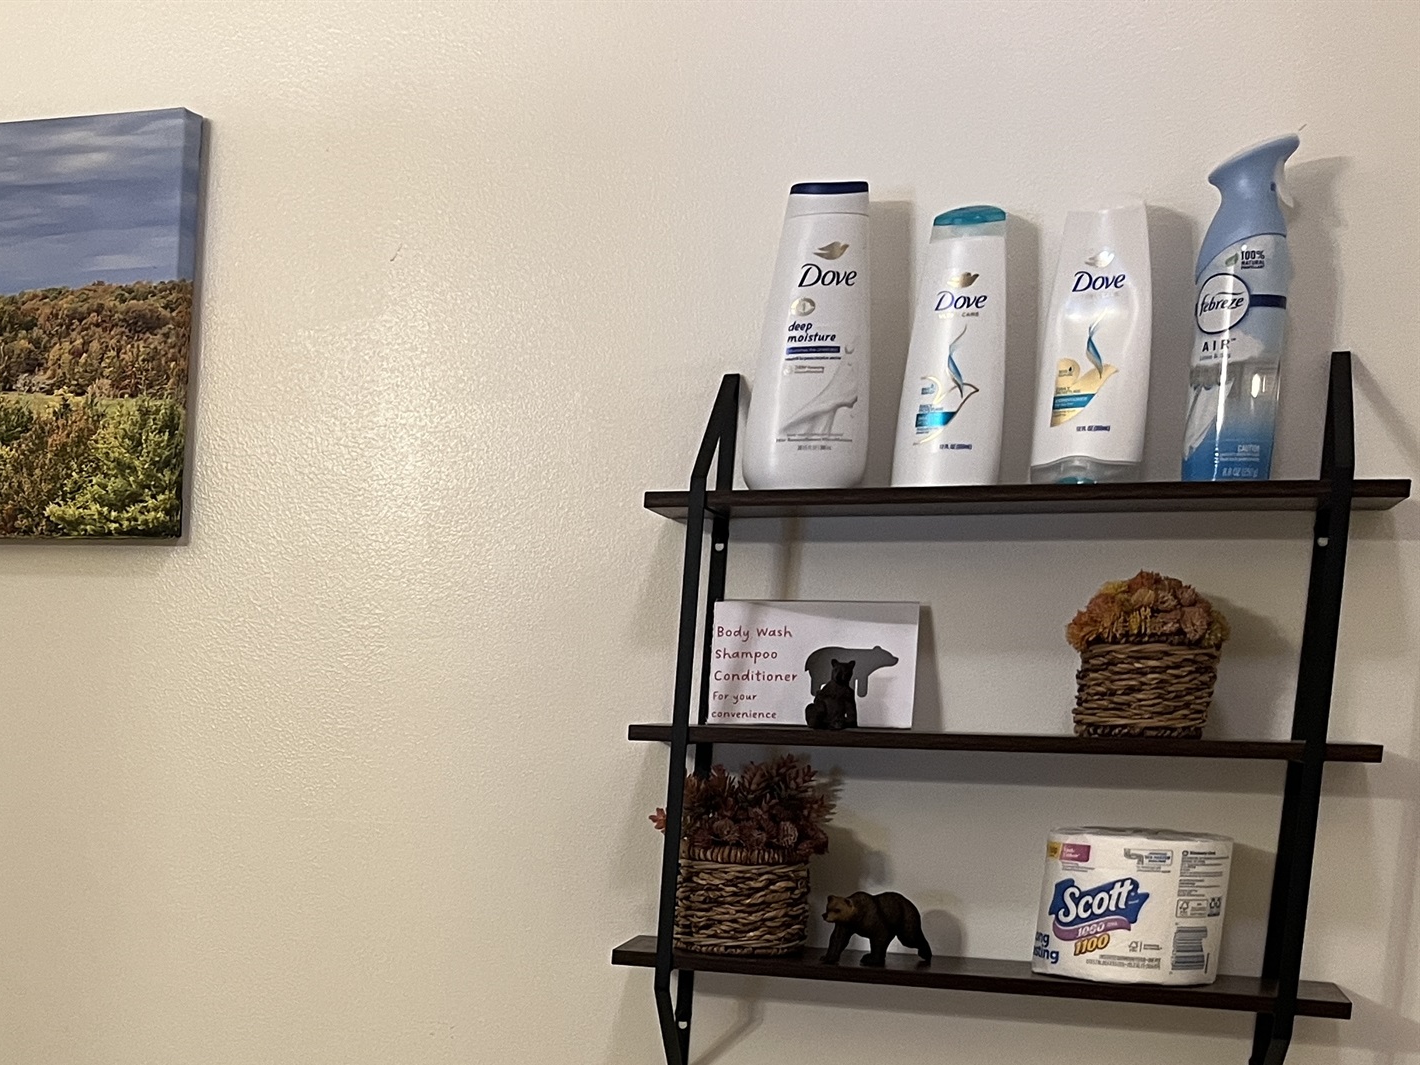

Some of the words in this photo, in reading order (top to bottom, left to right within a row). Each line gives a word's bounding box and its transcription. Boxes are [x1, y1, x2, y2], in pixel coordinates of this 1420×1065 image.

[1241, 248, 1266, 261] 100%
[798, 263, 857, 288] Dove
[1071, 270, 1126, 293] Dove
[934, 290, 988, 311] Dove
[1199, 291, 1245, 317] febreze
[788, 321, 813, 334] deep
[787, 332, 837, 343] moisture
[716, 625, 750, 642] Body
[756, 625, 793, 638] Wash
[715, 648, 778, 664] Shampoo
[714, 669, 798, 682] Conditioner
[712, 691, 729, 701] For
[732, 693, 757, 704] your
[711, 709, 777, 719] convenience
[1058, 879, 1133, 923] Scott
[1073, 932, 1111, 956] 1100
